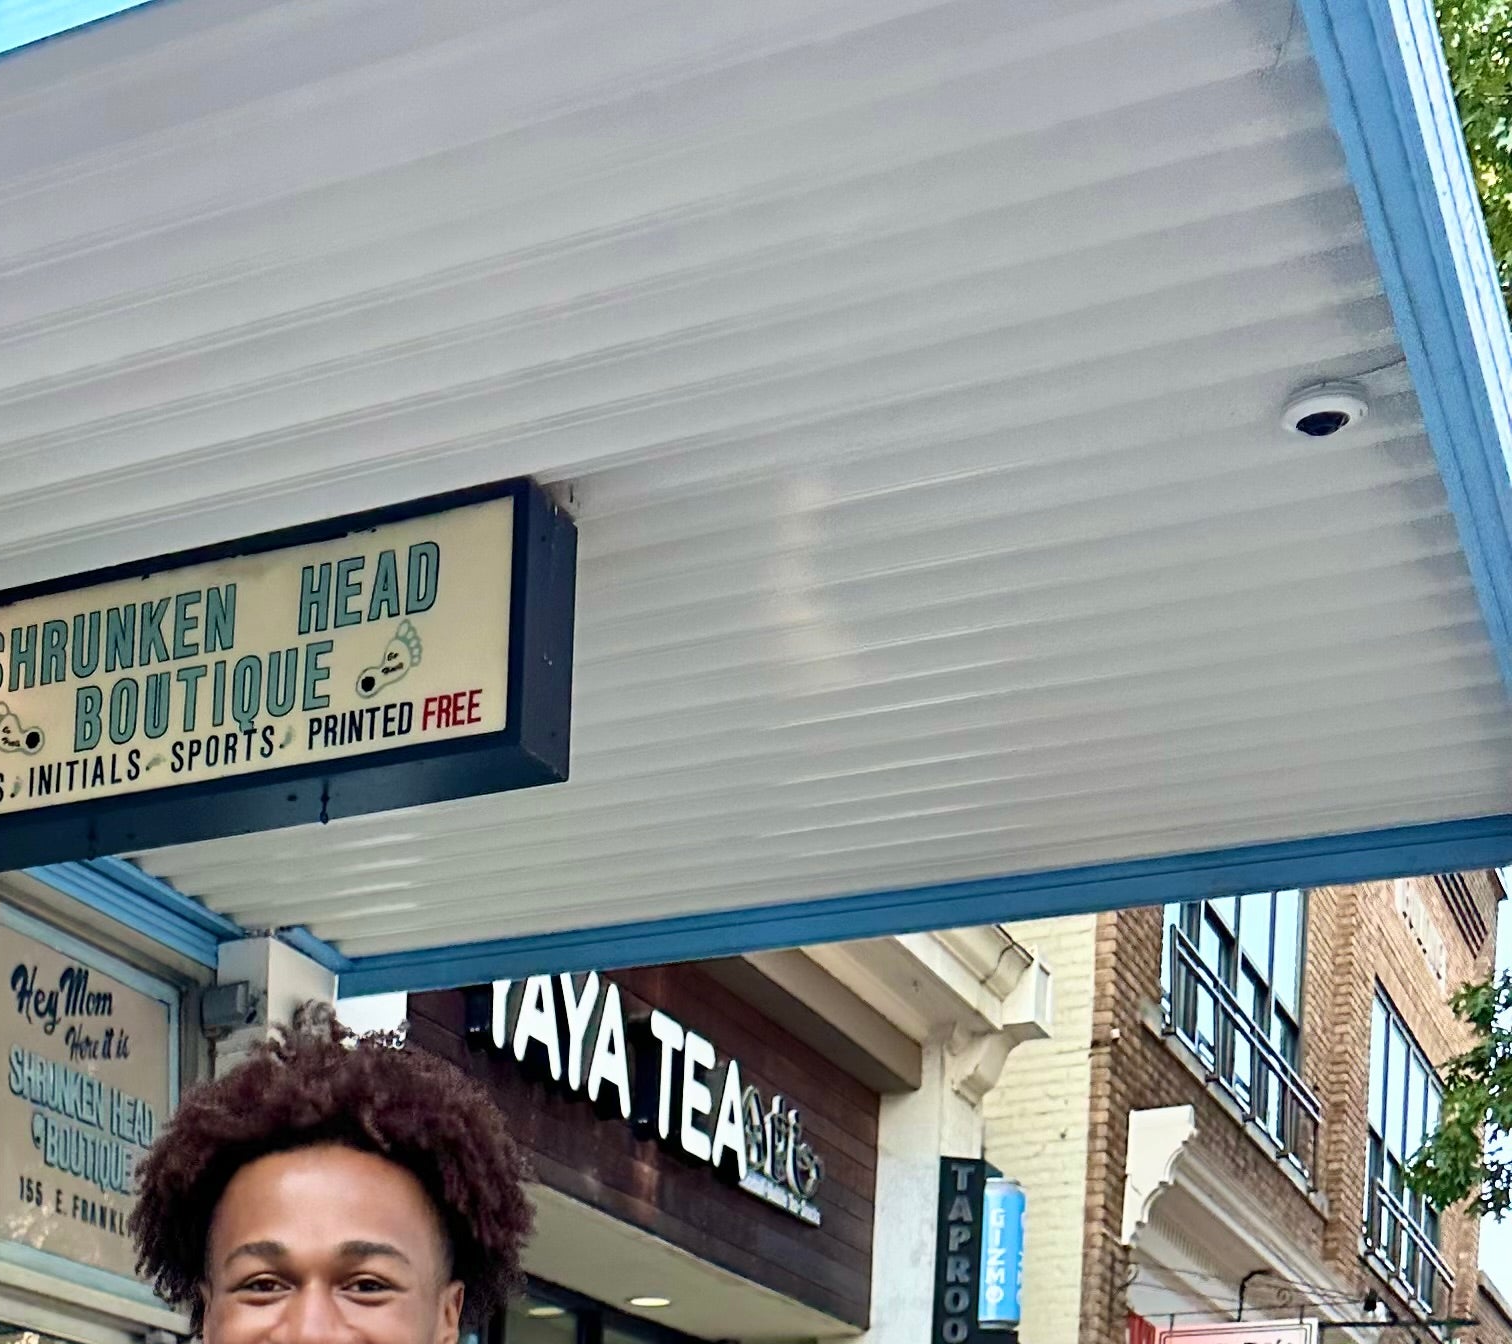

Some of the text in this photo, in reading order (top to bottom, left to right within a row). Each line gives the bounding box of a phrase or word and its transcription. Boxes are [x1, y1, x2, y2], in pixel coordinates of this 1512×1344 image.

[299, 541, 440, 635] HEAD
[28, 750, 141, 797] INITIALS
[170, 726, 274, 772] SPORTS
[307, 702, 414, 750] PRINTED
[422, 689, 482, 731] FREE
[74, 641, 333, 752] BOUTIQUE
[10, 963, 113, 1035] Hey Mom
[65, 1025, 98, 1061] Here
[8, 1046, 154, 1149] SHRUNKEN HEAD
[650, 1009, 748, 1181] TEA
[19, 1176, 43, 1207] 155
[43, 1118, 132, 1195] BOUTIQUE
[985, 1208, 1006, 1303] GIZMO
